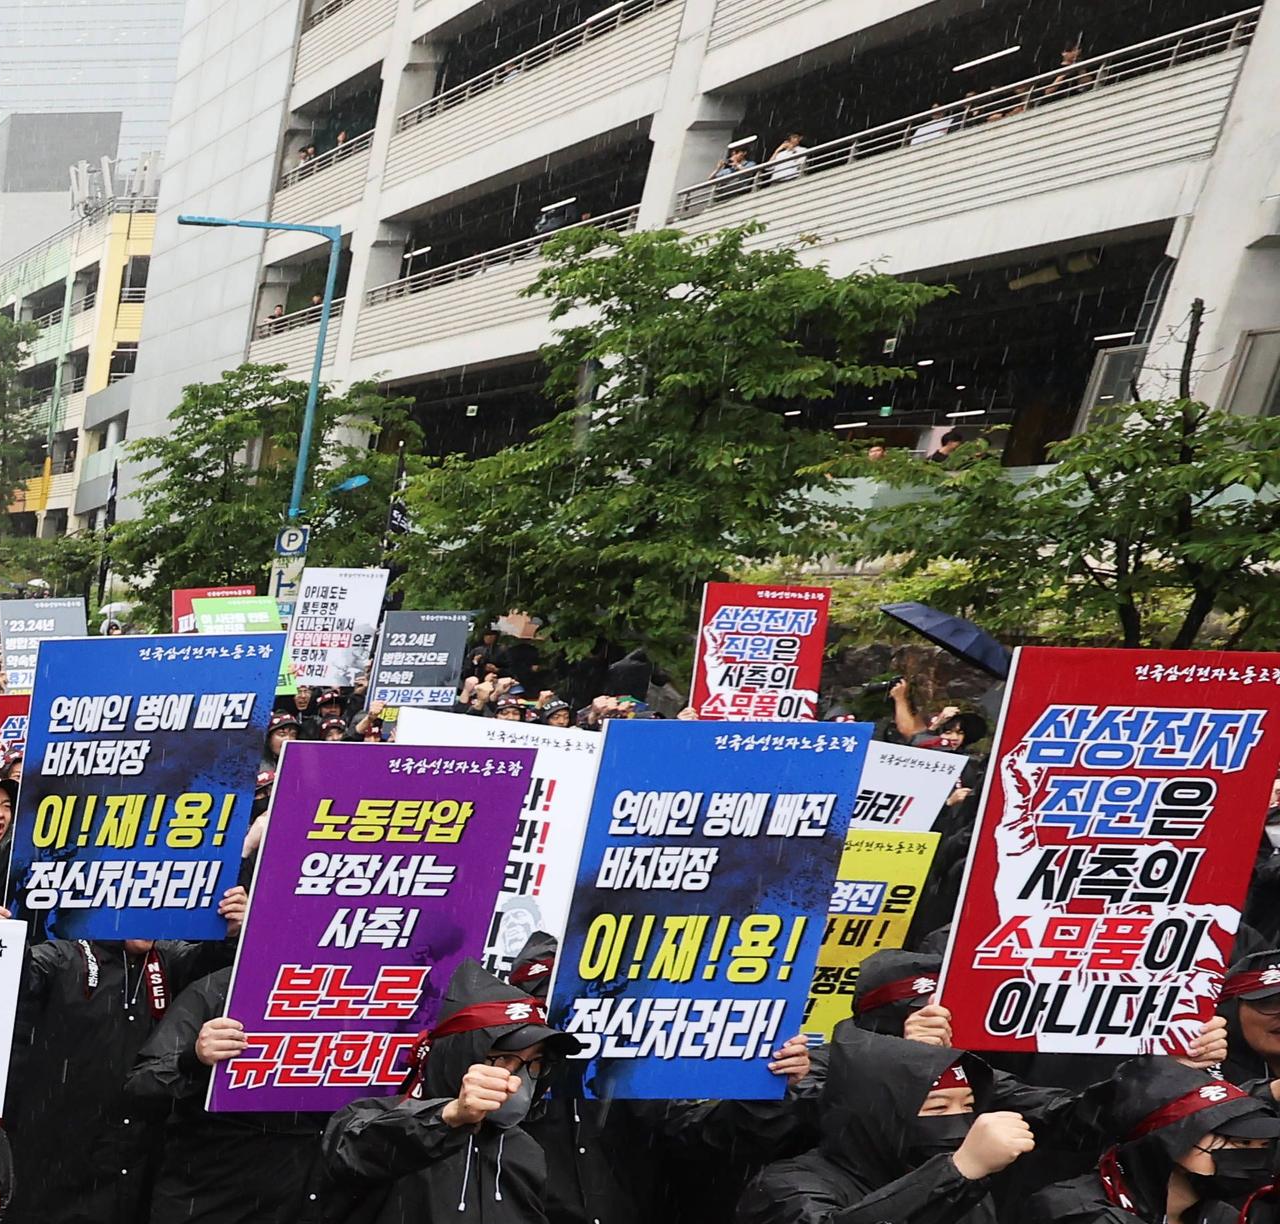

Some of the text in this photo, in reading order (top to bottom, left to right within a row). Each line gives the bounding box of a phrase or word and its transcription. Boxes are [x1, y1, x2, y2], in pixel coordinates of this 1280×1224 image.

[304, 585, 348, 600] OPI제도는
[301, 602, 338, 616] 불투명한
[714, 606, 818, 635] 삼성전자
[297, 616, 354, 632] EVA방식 에서
[138, 644, 274, 660] 전국삼성전자노동조합
[293, 632, 372, 648] 영업이익방식 으로
[722, 636, 800, 662] 직원은
[290, 648, 328, 663] 투명하게
[381, 651, 450, 666] 병합조건으로
[378, 670, 415, 686] 약속한
[718, 665, 795, 690] 사측의
[376, 687, 455, 704] 휴가일수 보상
[700, 692, 803, 719] 소모품이
[48, 696, 127, 735] 연예인
[135, 694, 185, 732] 병에
[193, 693, 256, 731] 빠진
[486, 729, 597, 754] 전국삼성전자노동조합
[714, 733, 858, 753] 전국삼성전자노동조합
[1023, 705, 1269, 773] 삼성전자
[41, 741, 151, 777] 바지회장
[388, 756, 524, 777] 전국삼성전자노동조합
[880, 753, 957, 774] 전국삼성전자노동조합
[306, 799, 476, 846] 노동탄압
[610, 789, 837, 840] 연예인 병에 빠진
[1038, 775, 1220, 842] 직원은
[294, 851, 456, 899] 앞장서는
[596, 847, 719, 894] 바지회장
[1017, 846, 1202, 907] 사측의
[24, 860, 217, 913] 정신차려라!
[882, 884, 917, 914] 은
[318, 907, 415, 951] 사측!
[972, 913, 1216, 972] 소모품이
[147, 961, 166, 1010] NSEU
[266, 963, 432, 1020] 분노로
[988, 981, 1182, 1039] 아니다!
[565, 996, 780, 1063] 정신차려라!
